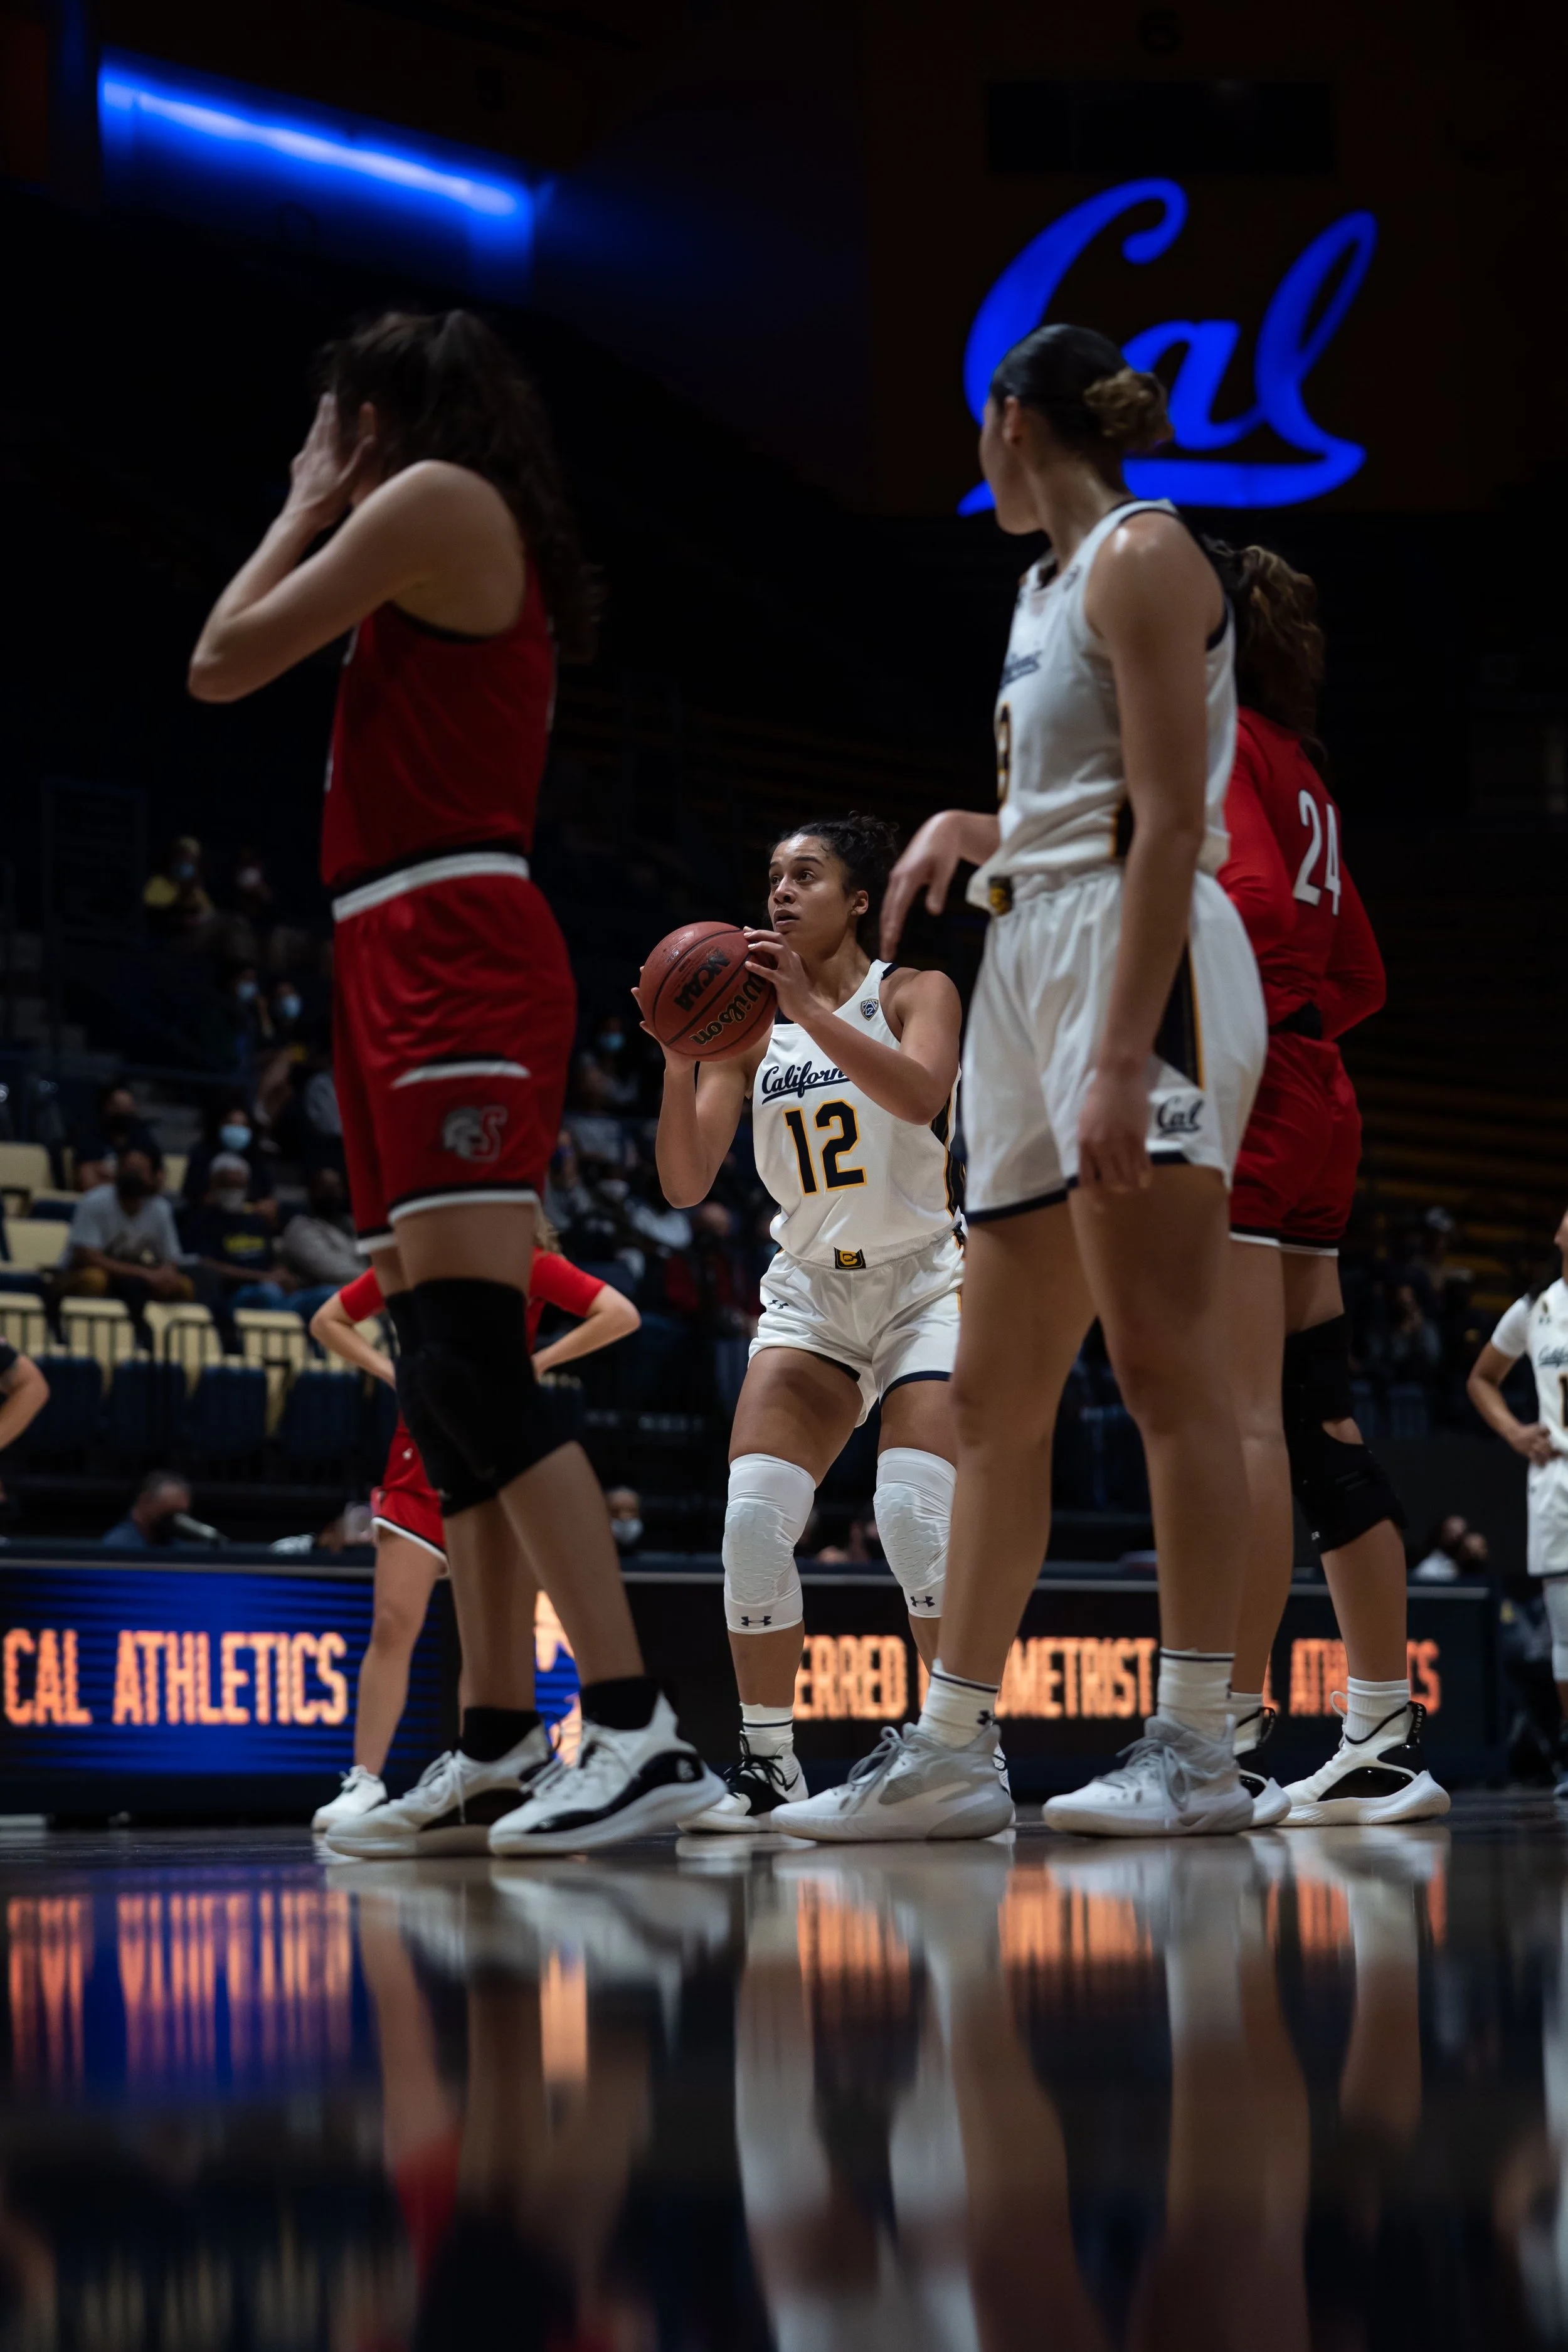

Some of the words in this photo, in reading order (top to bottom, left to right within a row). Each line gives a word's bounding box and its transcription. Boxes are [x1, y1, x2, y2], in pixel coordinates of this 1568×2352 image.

[956, 176, 1379, 517] Cal
[1292, 788, 1341, 916] 24
[674, 948, 731, 1012] NCAA
[689, 973, 767, 1046] Wilson
[762, 1061, 850, 1103] Californ
[1157, 1096, 1204, 1138] Cal
[783, 1099, 867, 1195] 12
[2, 1628, 93, 1727] CAL
[112, 1629, 349, 1727] ATHLETICS
[793, 1634, 909, 1720] ERRED
